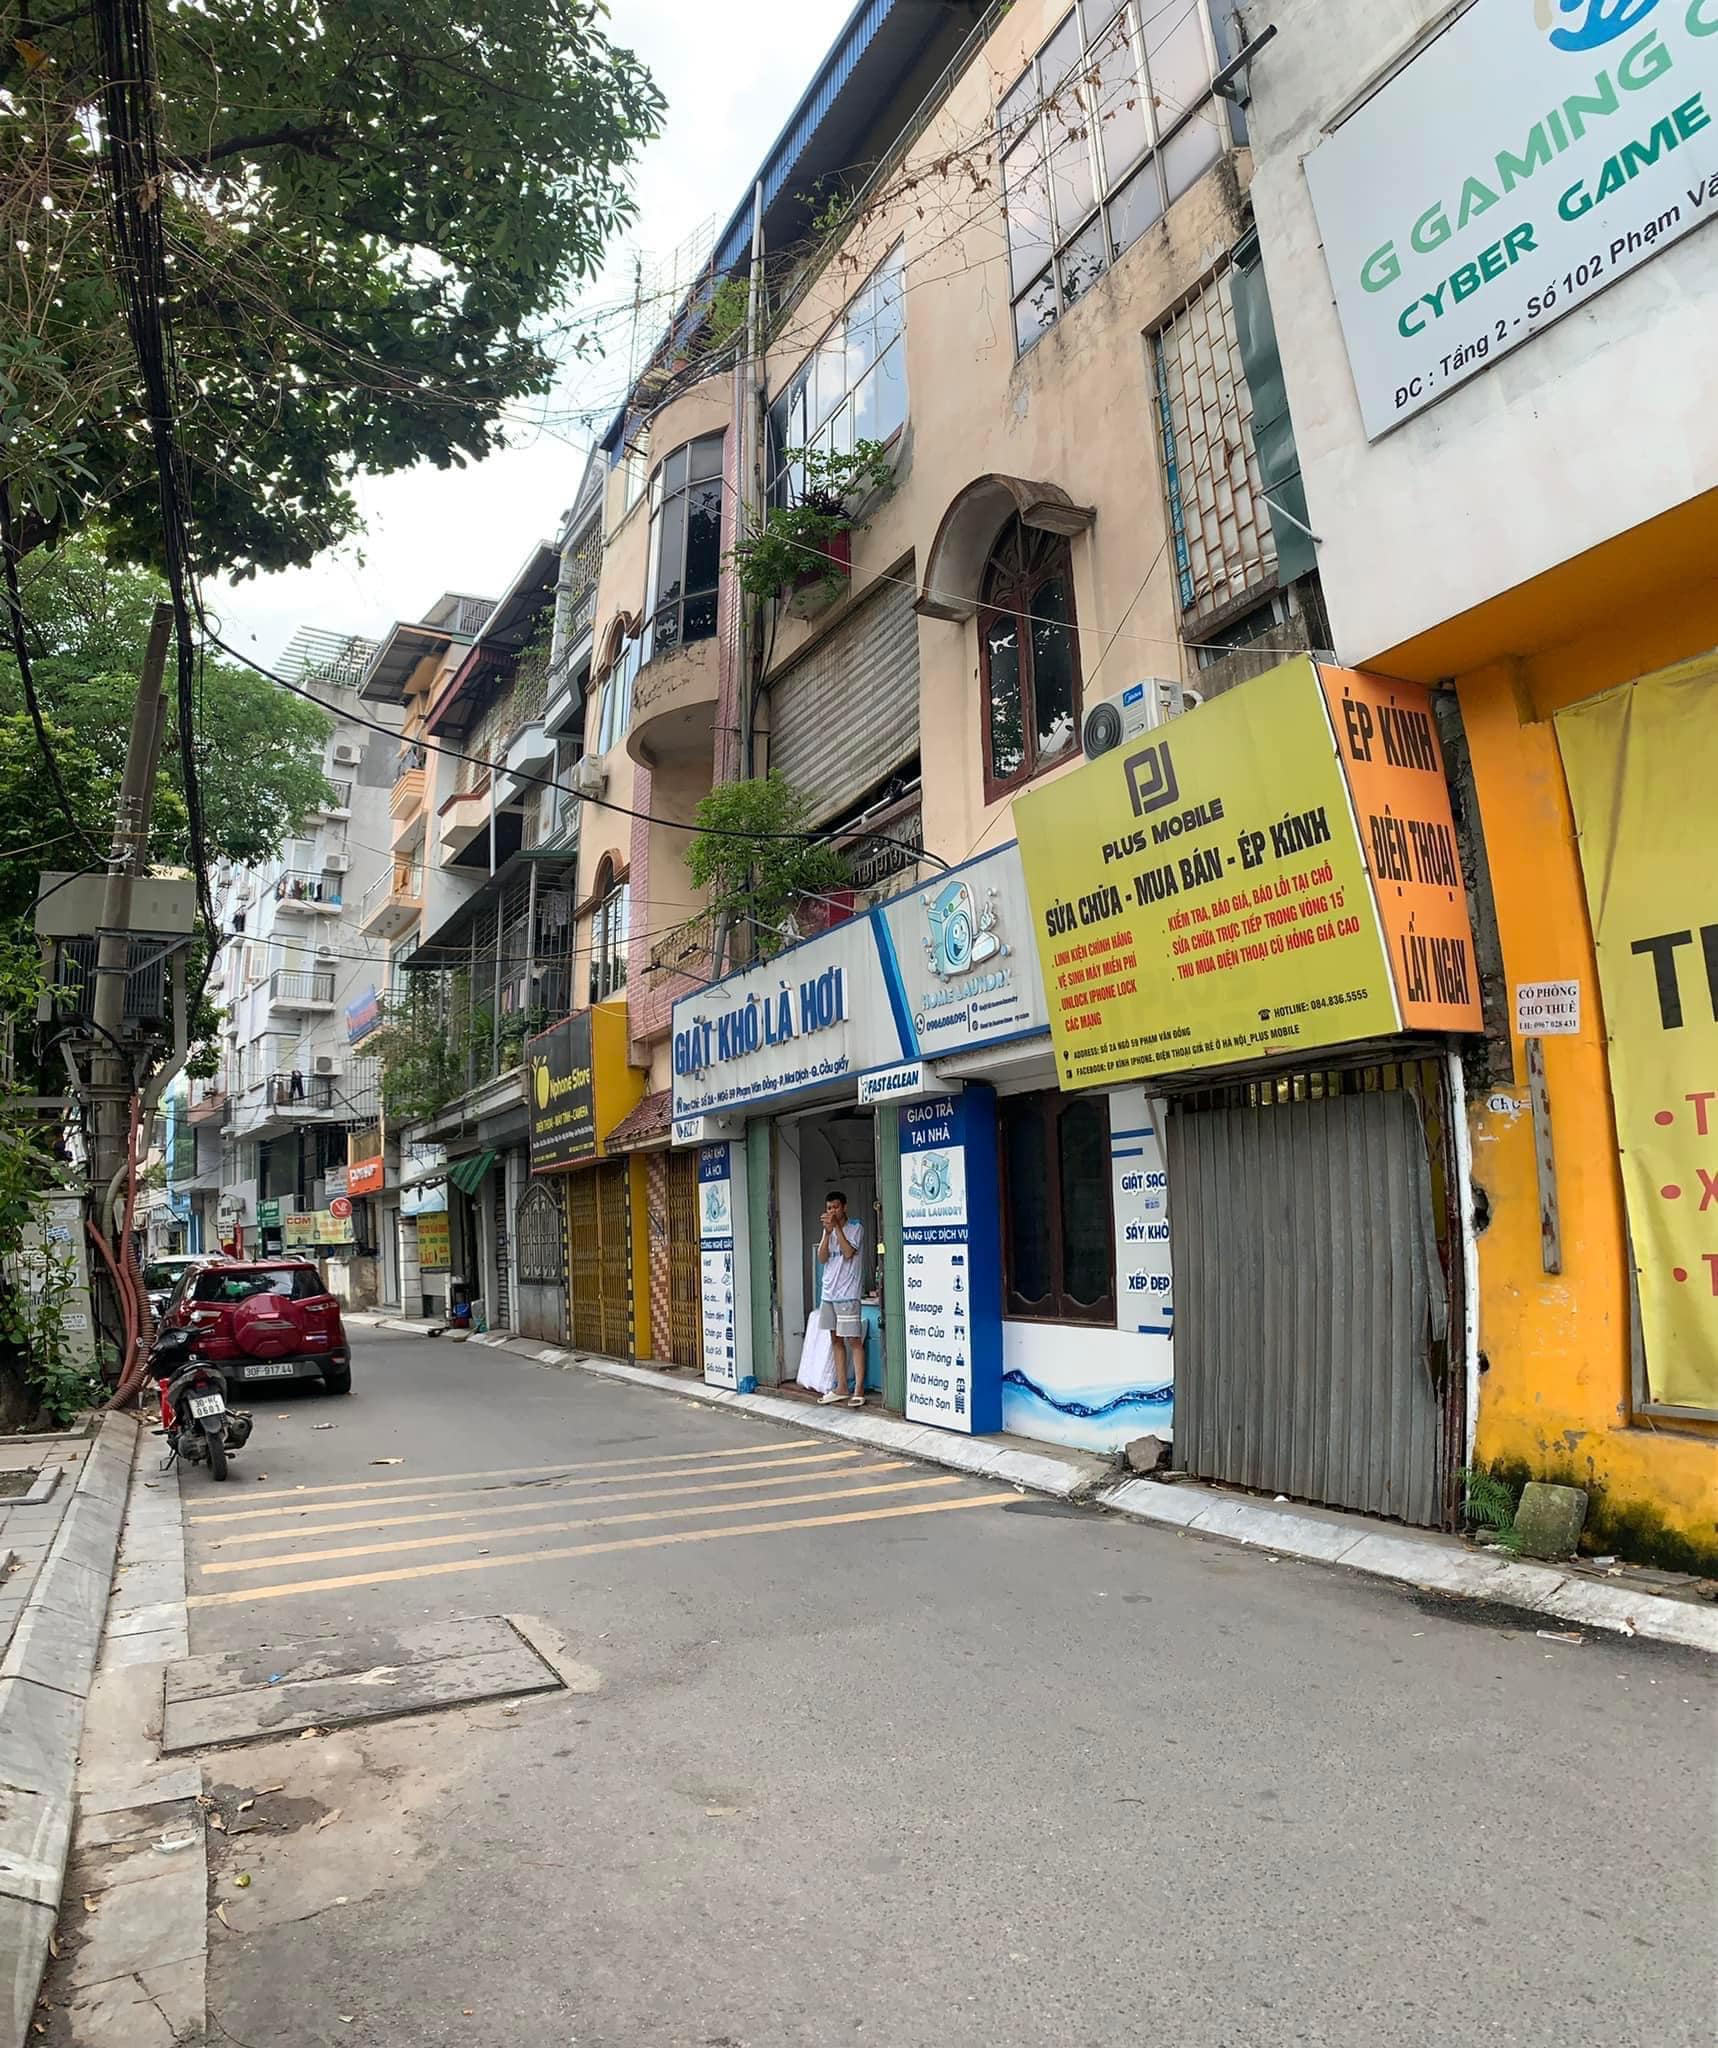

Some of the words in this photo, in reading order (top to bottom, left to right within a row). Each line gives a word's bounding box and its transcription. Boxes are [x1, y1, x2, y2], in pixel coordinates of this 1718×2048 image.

[1361, 239, 1402, 293] G
[1410, 28, 1674, 254] GAMING
[1397, 222, 1539, 338] CYBER
[1557, 91, 1712, 222] GAME
[1439, 336, 1490, 377] Tầng
[1495, 319, 1509, 342] 2
[1527, 279, 1560, 319] Số
[1562, 255, 1605, 296] 102
[1609, 204, 1682, 266] Phạm
[1341, 686, 1373, 762] ÉP
[1376, 695, 1438, 772] KÍNH
[1101, 830, 1148, 864] PLUS
[1151, 798, 1225, 845] MOBILE
[1369, 804, 1413, 897] ĐIỆN
[1408, 820, 1458, 903] THOẠI
[1045, 898, 1078, 938] SỬA
[1078, 884, 1123, 926] CHỮA
[1133, 864, 1179, 906] MUA
[1178, 847, 1224, 891] BÁN
[1237, 829, 1266, 870] ÉP
[1269, 806, 1332, 859] KÍNH
[1211, 897, 1231, 919] BÁO
[1252, 885, 1274, 906] BÁO
[1292, 874, 1310, 896] TẠI
[1264, 904, 1298, 930] TRONG
[1298, 894, 1329, 919] VÒNG
[1176, 961, 1194, 981] THU
[1195, 956, 1217, 977] MUA
[1240, 941, 1269, 963] THOẠI
[1316, 919, 1337, 942] GIÁ
[1337, 915, 1361, 937] CAO
[1400, 911, 1432, 1003] LẤY
[1429, 937, 1471, 1006] NGAY
[1068, 968, 1087, 987] SINH
[1060, 991, 1090, 1012] UNLOCK
[1088, 985, 1118, 1006] IPHONE
[1116, 978, 1138, 997] LOCK
[1536, 984, 1577, 999] PHÒNG
[674, 1015, 716, 1081] GIẶT
[717, 992, 762, 1062] KHÔ
[764, 980, 799, 1046] LÀ
[799, 965, 849, 1034] HƠI
[1064, 1016, 1080, 1033] CÁC
[1079, 1011, 1103, 1031] MẠNG
[1274, 1003, 1309, 1018] HOTLINE:
[1519, 1004, 1543, 1017] CHO
[1564, 1019, 1577, 1028] 431
[1074, 1046, 1100, 1060] ADDRESS:
[1130, 1037, 1140, 1048] 59
[1076, 1062, 1107, 1077] FACEBOOK:
[1269, 1024, 1301, 1040] MOBILE
[906, 1106, 934, 1124] GIAO
[935, 1096, 955, 1118] TRẢ
[911, 1129, 926, 1147] TẠI
[927, 1122, 951, 1143] NHÀ
[906, 1207, 927, 1219] HOME
[1125, 1217, 1144, 1241] SẤY
[907, 1253, 924, 1264] Sofa
[907, 1277, 922, 1289] Spa
[1128, 1269, 1148, 1291] XẾP
[1150, 1275, 1170, 1295] ĐẸP
[908, 1301, 944, 1316] Message
[909, 1391, 934, 1408] Khách
